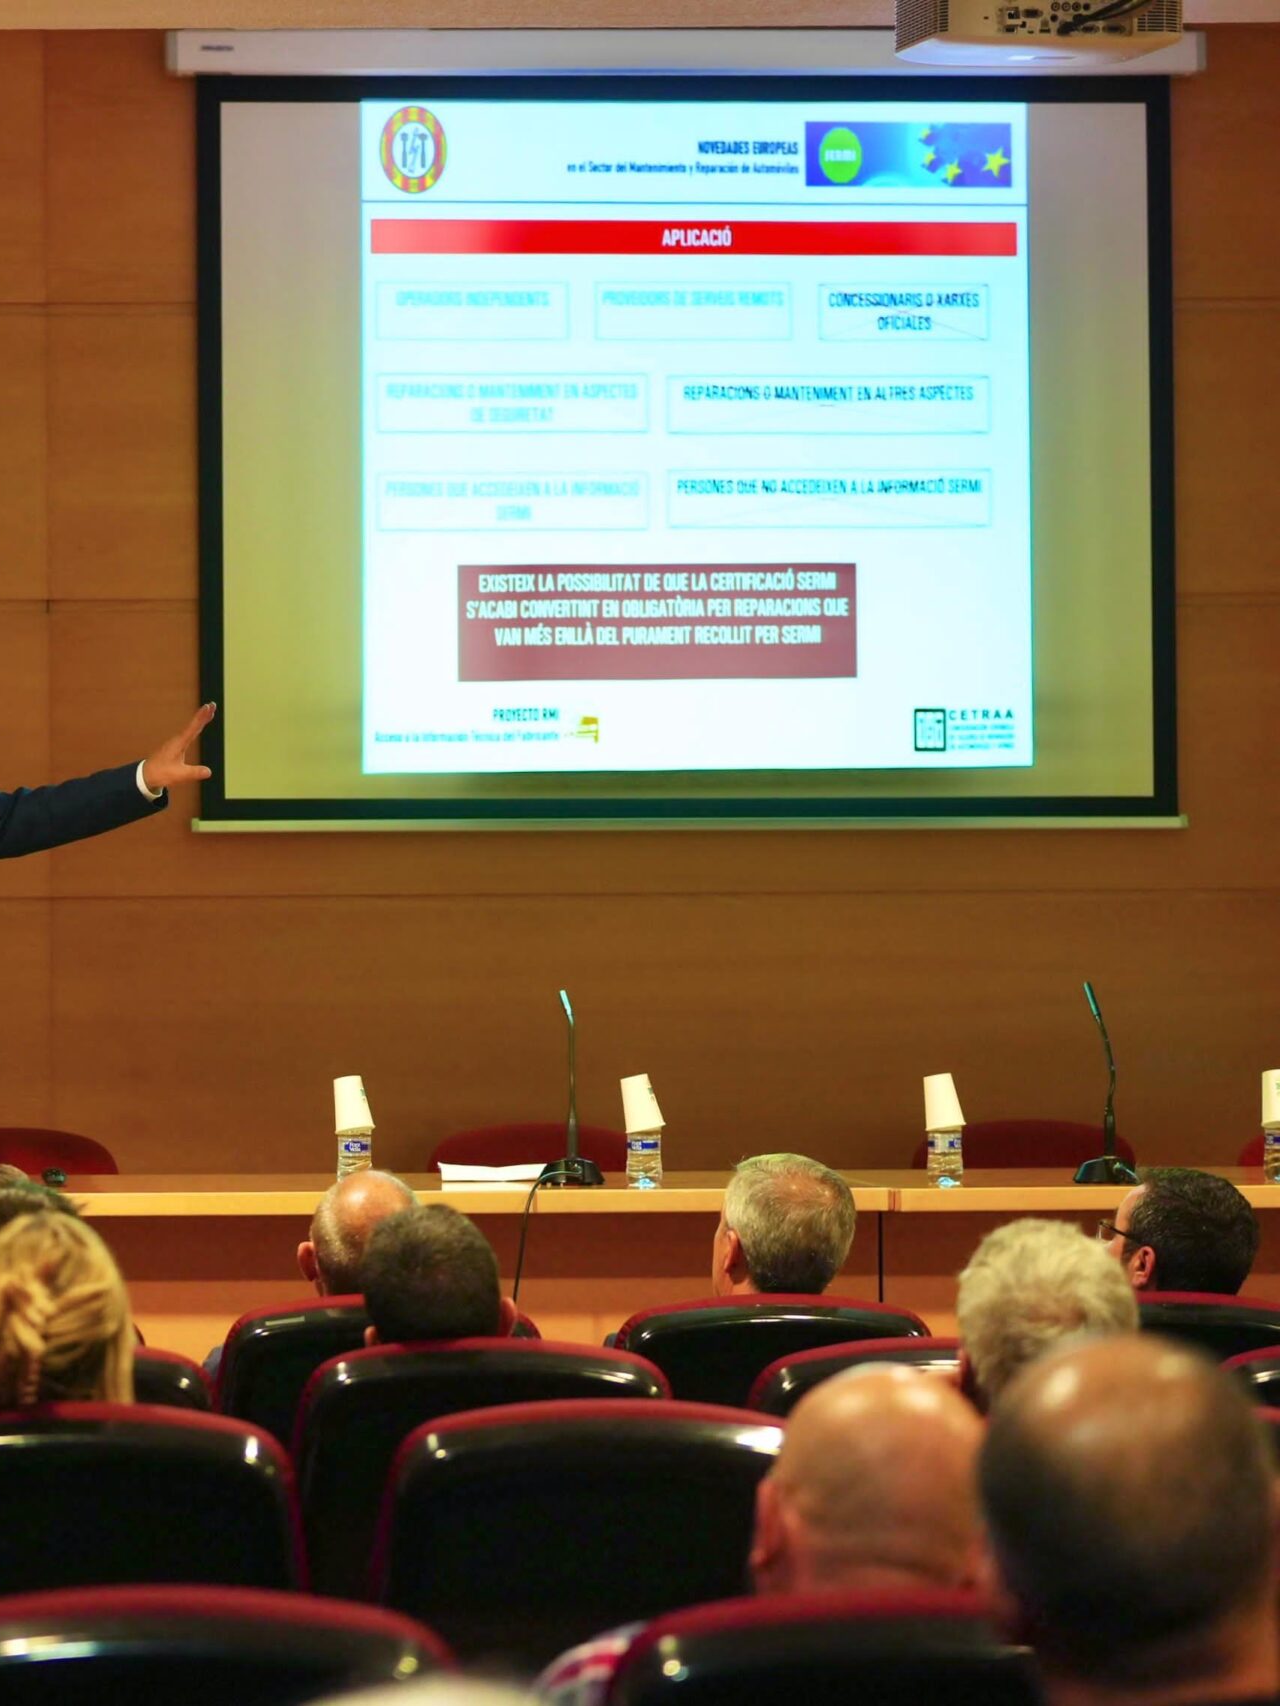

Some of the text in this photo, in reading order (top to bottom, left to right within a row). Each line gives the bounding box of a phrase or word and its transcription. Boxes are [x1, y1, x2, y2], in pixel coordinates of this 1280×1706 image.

[697, 141, 799, 155] NOVEDADES EUROPEAS
[589, 161, 613, 173] Sector
[616, 161, 627, 173] del
[629, 161, 686, 173] Mantenimiento
[741, 162, 750, 173] de
[661, 226, 732, 248] APLICACIÓ
[828, 292, 980, 308] CONCESSIONARIS O XARXES
[877, 315, 932, 331] OFICIALES
[563, 383, 579, 400] EN
[683, 385, 974, 401] REPARACIONS O MANTENIMENT EN ALTRES ASPECTES
[553, 480, 568, 497] LA
[677, 478, 982, 495] PERSONES QUE NO ACCEDEIXEN A LA INFORMACIÓ SERMI
[478, 568, 837, 593] EXISTEIX LA POSSIBILITAT DE QUE LA CERTIFICACIÓ SERMI
[466, 595, 849, 619] S'ACABI CONVERTINT EN OBLIGATÒRIA PER REPARACIONS QUE
[494, 621, 822, 646] VAN MÉS ENLLÀ DEL PURAMENT RECOLLIT PER SERMI
[492, 708, 560, 722] PROYECTO RMI
[949, 709, 1013, 721] CETRAA
